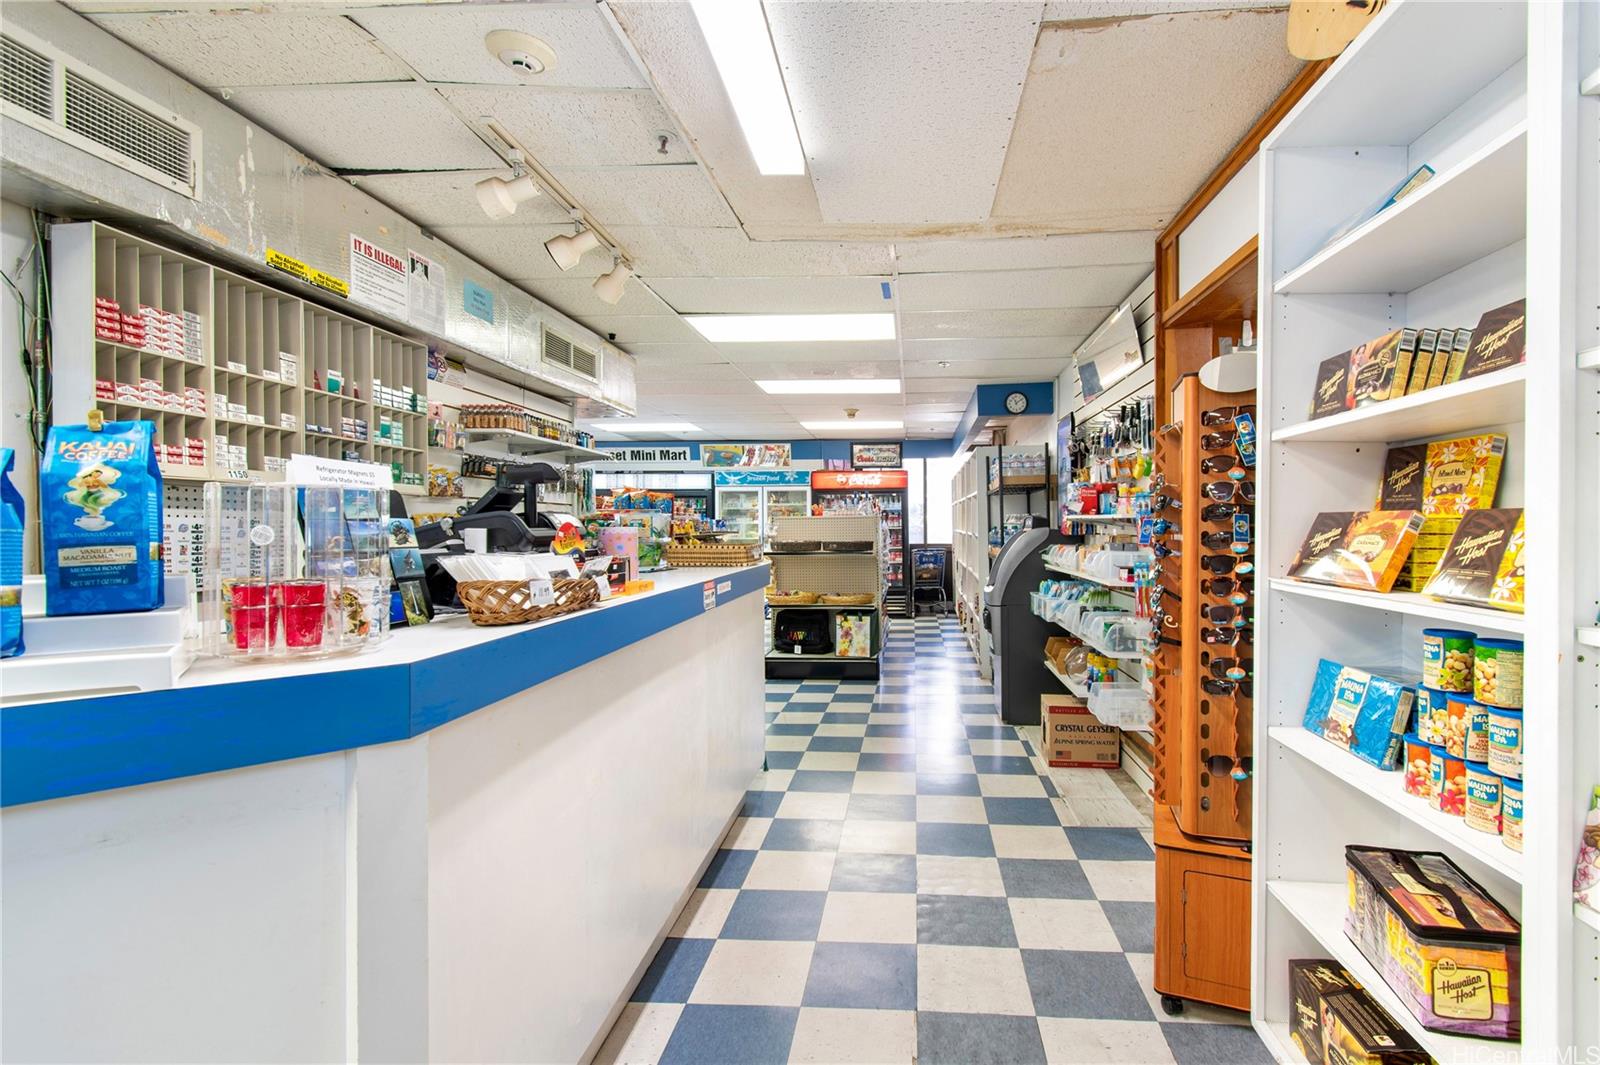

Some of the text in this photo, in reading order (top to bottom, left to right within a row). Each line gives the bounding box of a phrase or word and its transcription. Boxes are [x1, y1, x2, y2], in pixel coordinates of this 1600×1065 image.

[354, 239, 362, 252] IT
[364, 244, 372, 257] IS
[284, 258, 304, 270] Alcohol
[58, 441, 136, 455] KAUAI
[64, 450, 128, 460] COFFEE
[630, 450, 656, 460] Mini
[660, 450, 687, 460] Mart
[229, 470, 248, 478] 1150
[1454, 529, 1504, 556] Hawaiian
[1459, 540, 1502, 566] Host
[1055, 724, 1116, 733] CRYSTAL GEYSER
[1437, 975, 1482, 995] Hawaiian
[1450, 985, 1486, 1004] Host
